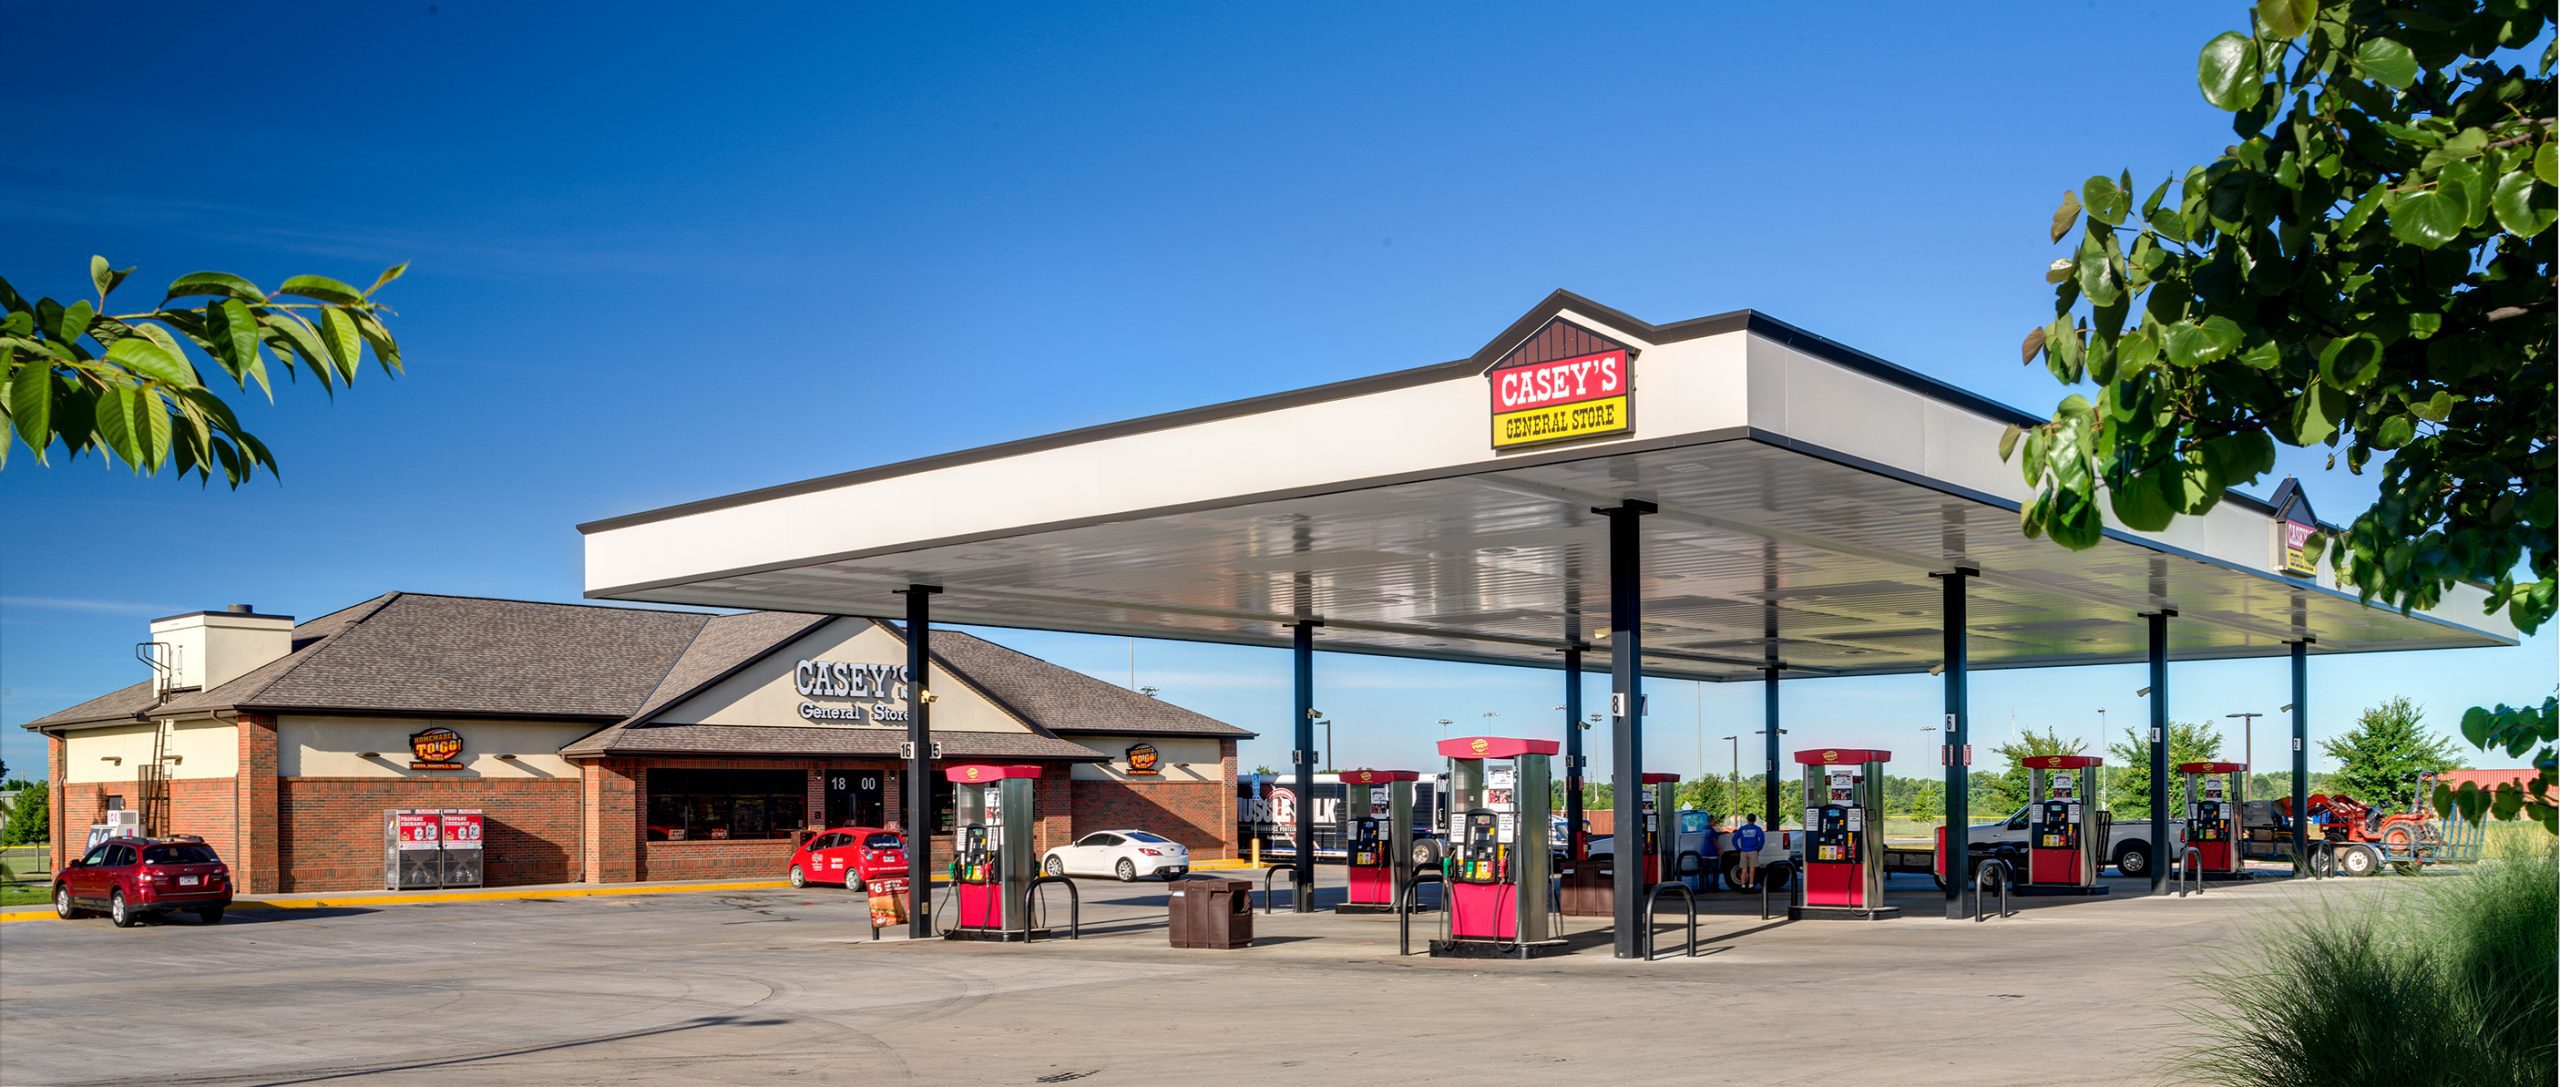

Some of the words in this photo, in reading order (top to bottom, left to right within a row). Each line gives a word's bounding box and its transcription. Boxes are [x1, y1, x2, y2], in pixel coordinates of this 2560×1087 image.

[1502, 357, 1618, 406] CASEY'S
[1506, 411, 1569, 439] GENERAL
[1572, 404, 1615, 431] STORE
[800, 702, 860, 720] General
[1612, 695, 1619, 714] 8
[1947, 715, 1952, 731] 6
[414, 732, 452, 744] HOMEMADE
[416, 742, 436, 757] TO
[439, 739, 462, 753] GO!
[901, 743, 912, 757] 16
[831, 777, 846, 790] 18
[861, 777, 876, 790] 00
